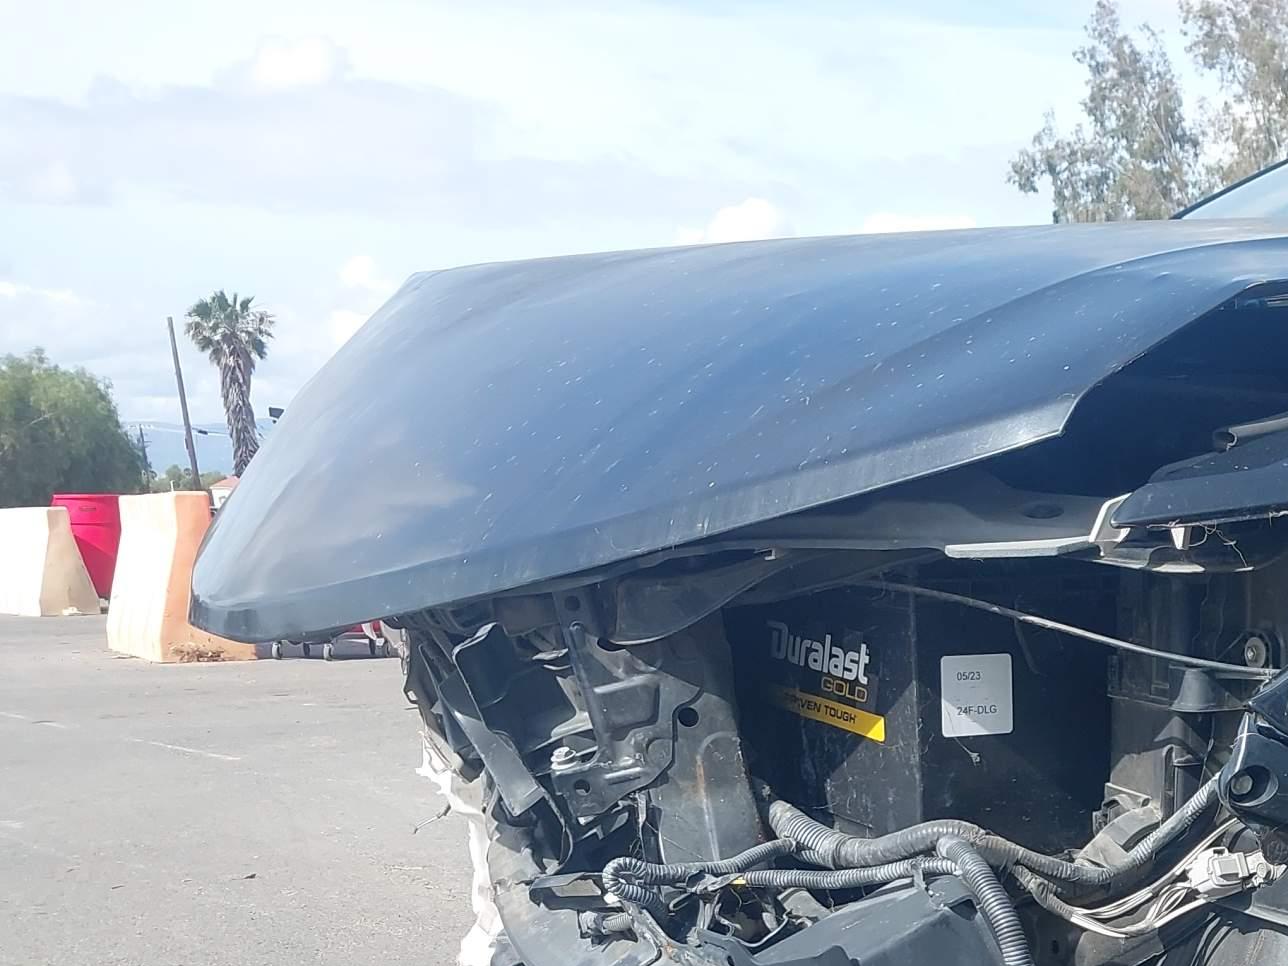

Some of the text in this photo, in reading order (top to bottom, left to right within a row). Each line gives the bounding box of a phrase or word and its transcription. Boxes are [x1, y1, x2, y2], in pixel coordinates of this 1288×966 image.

[769, 621, 870, 684] Duralast
[956, 671, 982, 681] 05/23
[820, 676, 869, 703] GOLD
[823, 704, 857, 725] TOUGH
[956, 704, 998, 716] 24F-DLG
